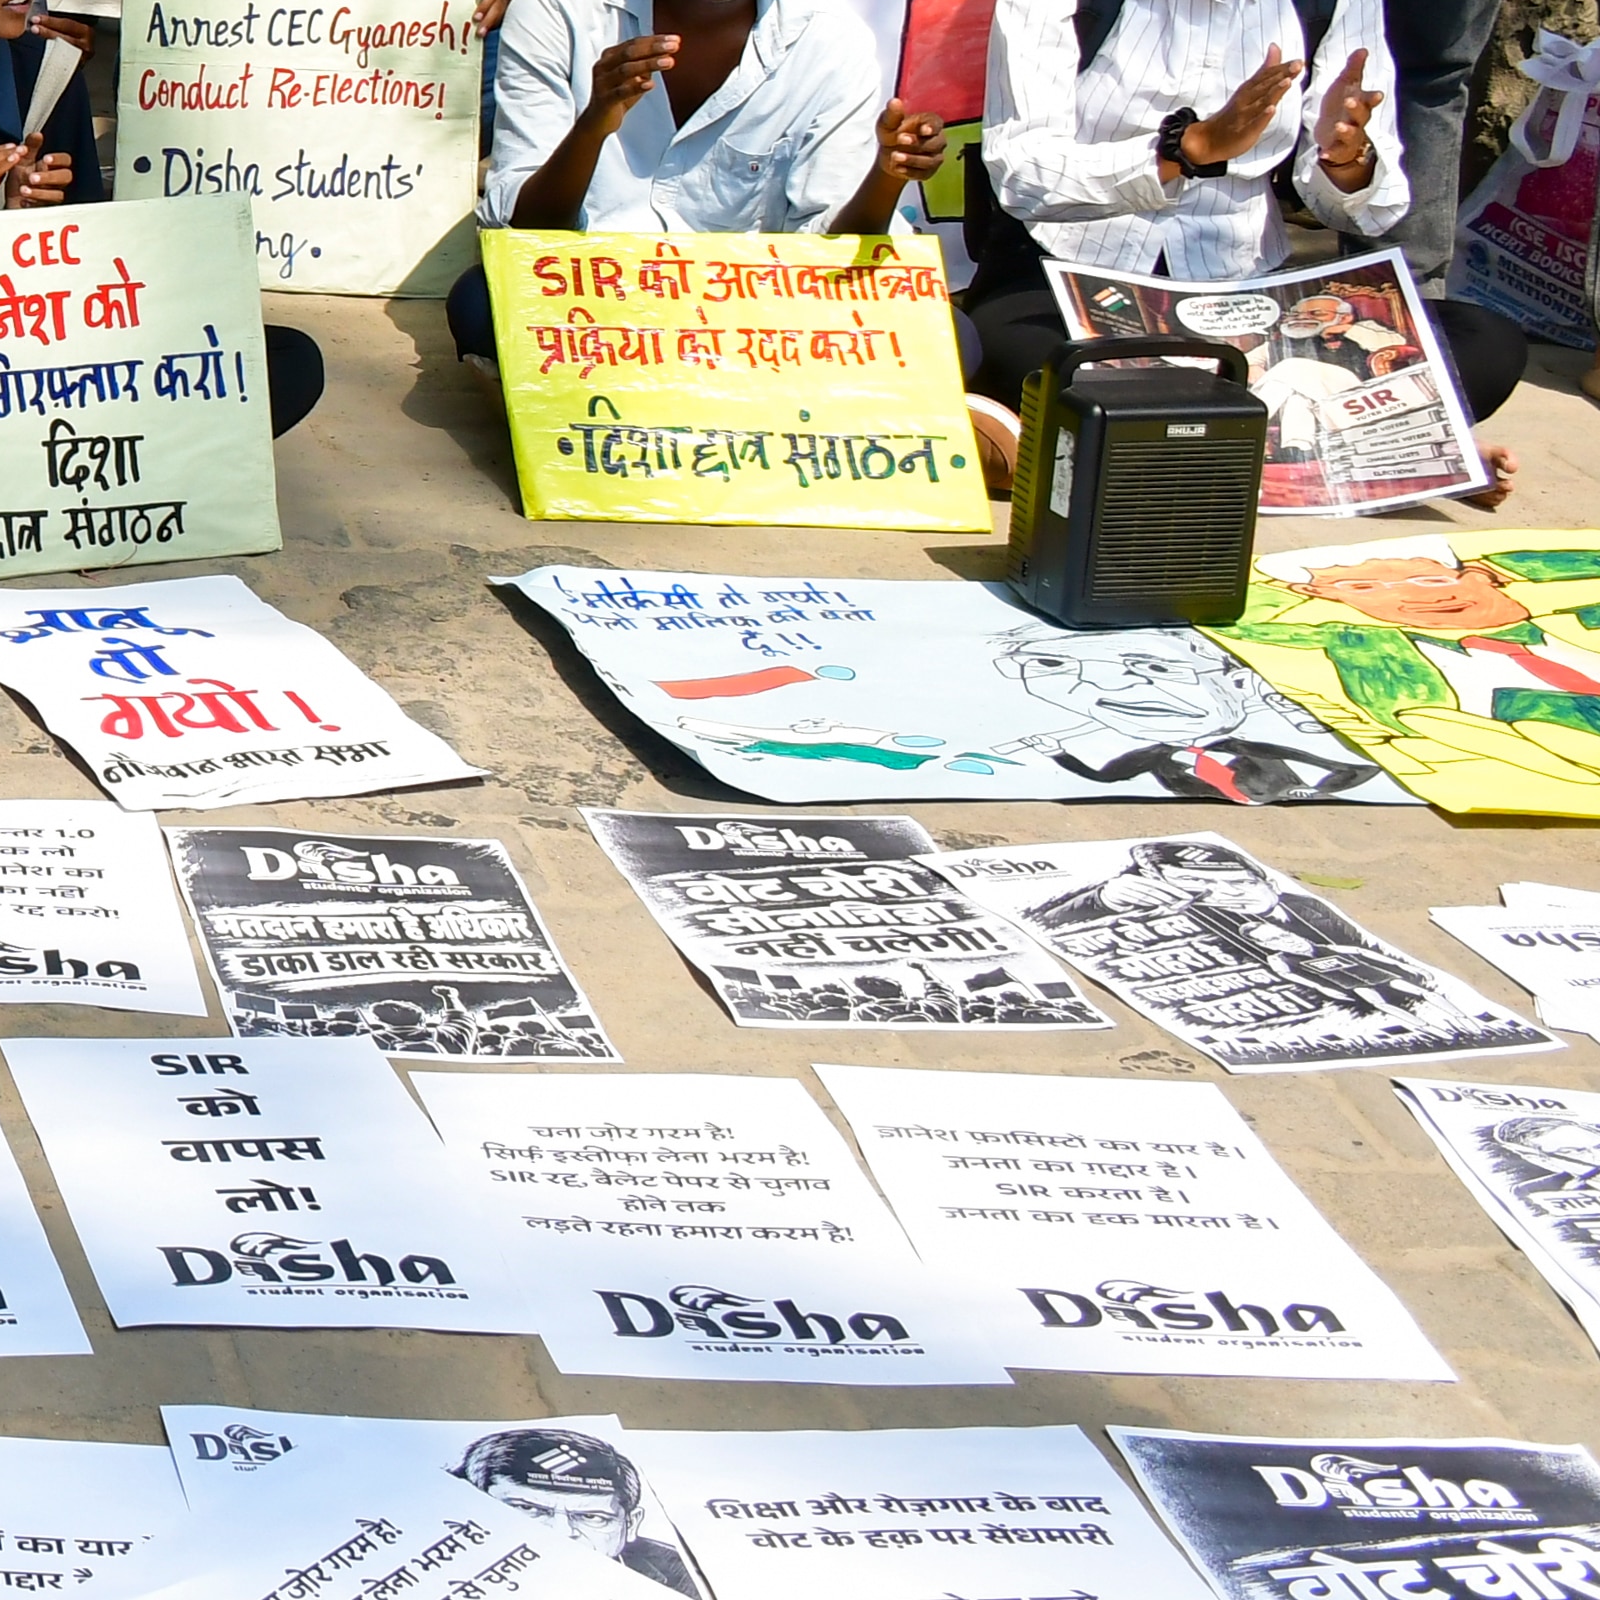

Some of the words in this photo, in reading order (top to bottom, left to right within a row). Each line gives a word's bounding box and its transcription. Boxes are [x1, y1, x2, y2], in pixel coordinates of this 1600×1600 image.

[147, 3, 260, 47] Arrest
[268, 9, 323, 46] CEC
[330, 1, 471, 68] Gyanesh!
[139, 63, 253, 110] Conduct
[268, 68, 445, 120] Re-Elections!
[162, 148, 262, 197] Disha
[272, 149, 422, 201] students'
[12, 225, 81, 268] CEC
[533, 256, 626, 301] SIR
[639, 242, 694, 300] की
[1529, 251, 1583, 285] BOOKS
[1556, 241, 1586, 269] ISC
[84, 258, 146, 329] को
[154, 325, 247, 402] करो!
[526, 307, 664, 379] प्रक्रिया
[810, 310, 905, 367] करो!
[1343, 390, 1399, 415] SIR
[42, 419, 144, 492] दिशा
[569, 396, 692, 478] दिशा
[692, 429, 774, 482] छात्र
[781, 410, 947, 488] संगठन
[62, 498, 187, 549] संगठन
[89, 637, 180, 684] तो
[80, 679, 341, 739] गयो!
[241, 840, 460, 886] Disha
[678, 819, 854, 855] Disha
[599, 1284, 910, 1343] Disha
[1251, 1454, 1518, 1509] Disha
